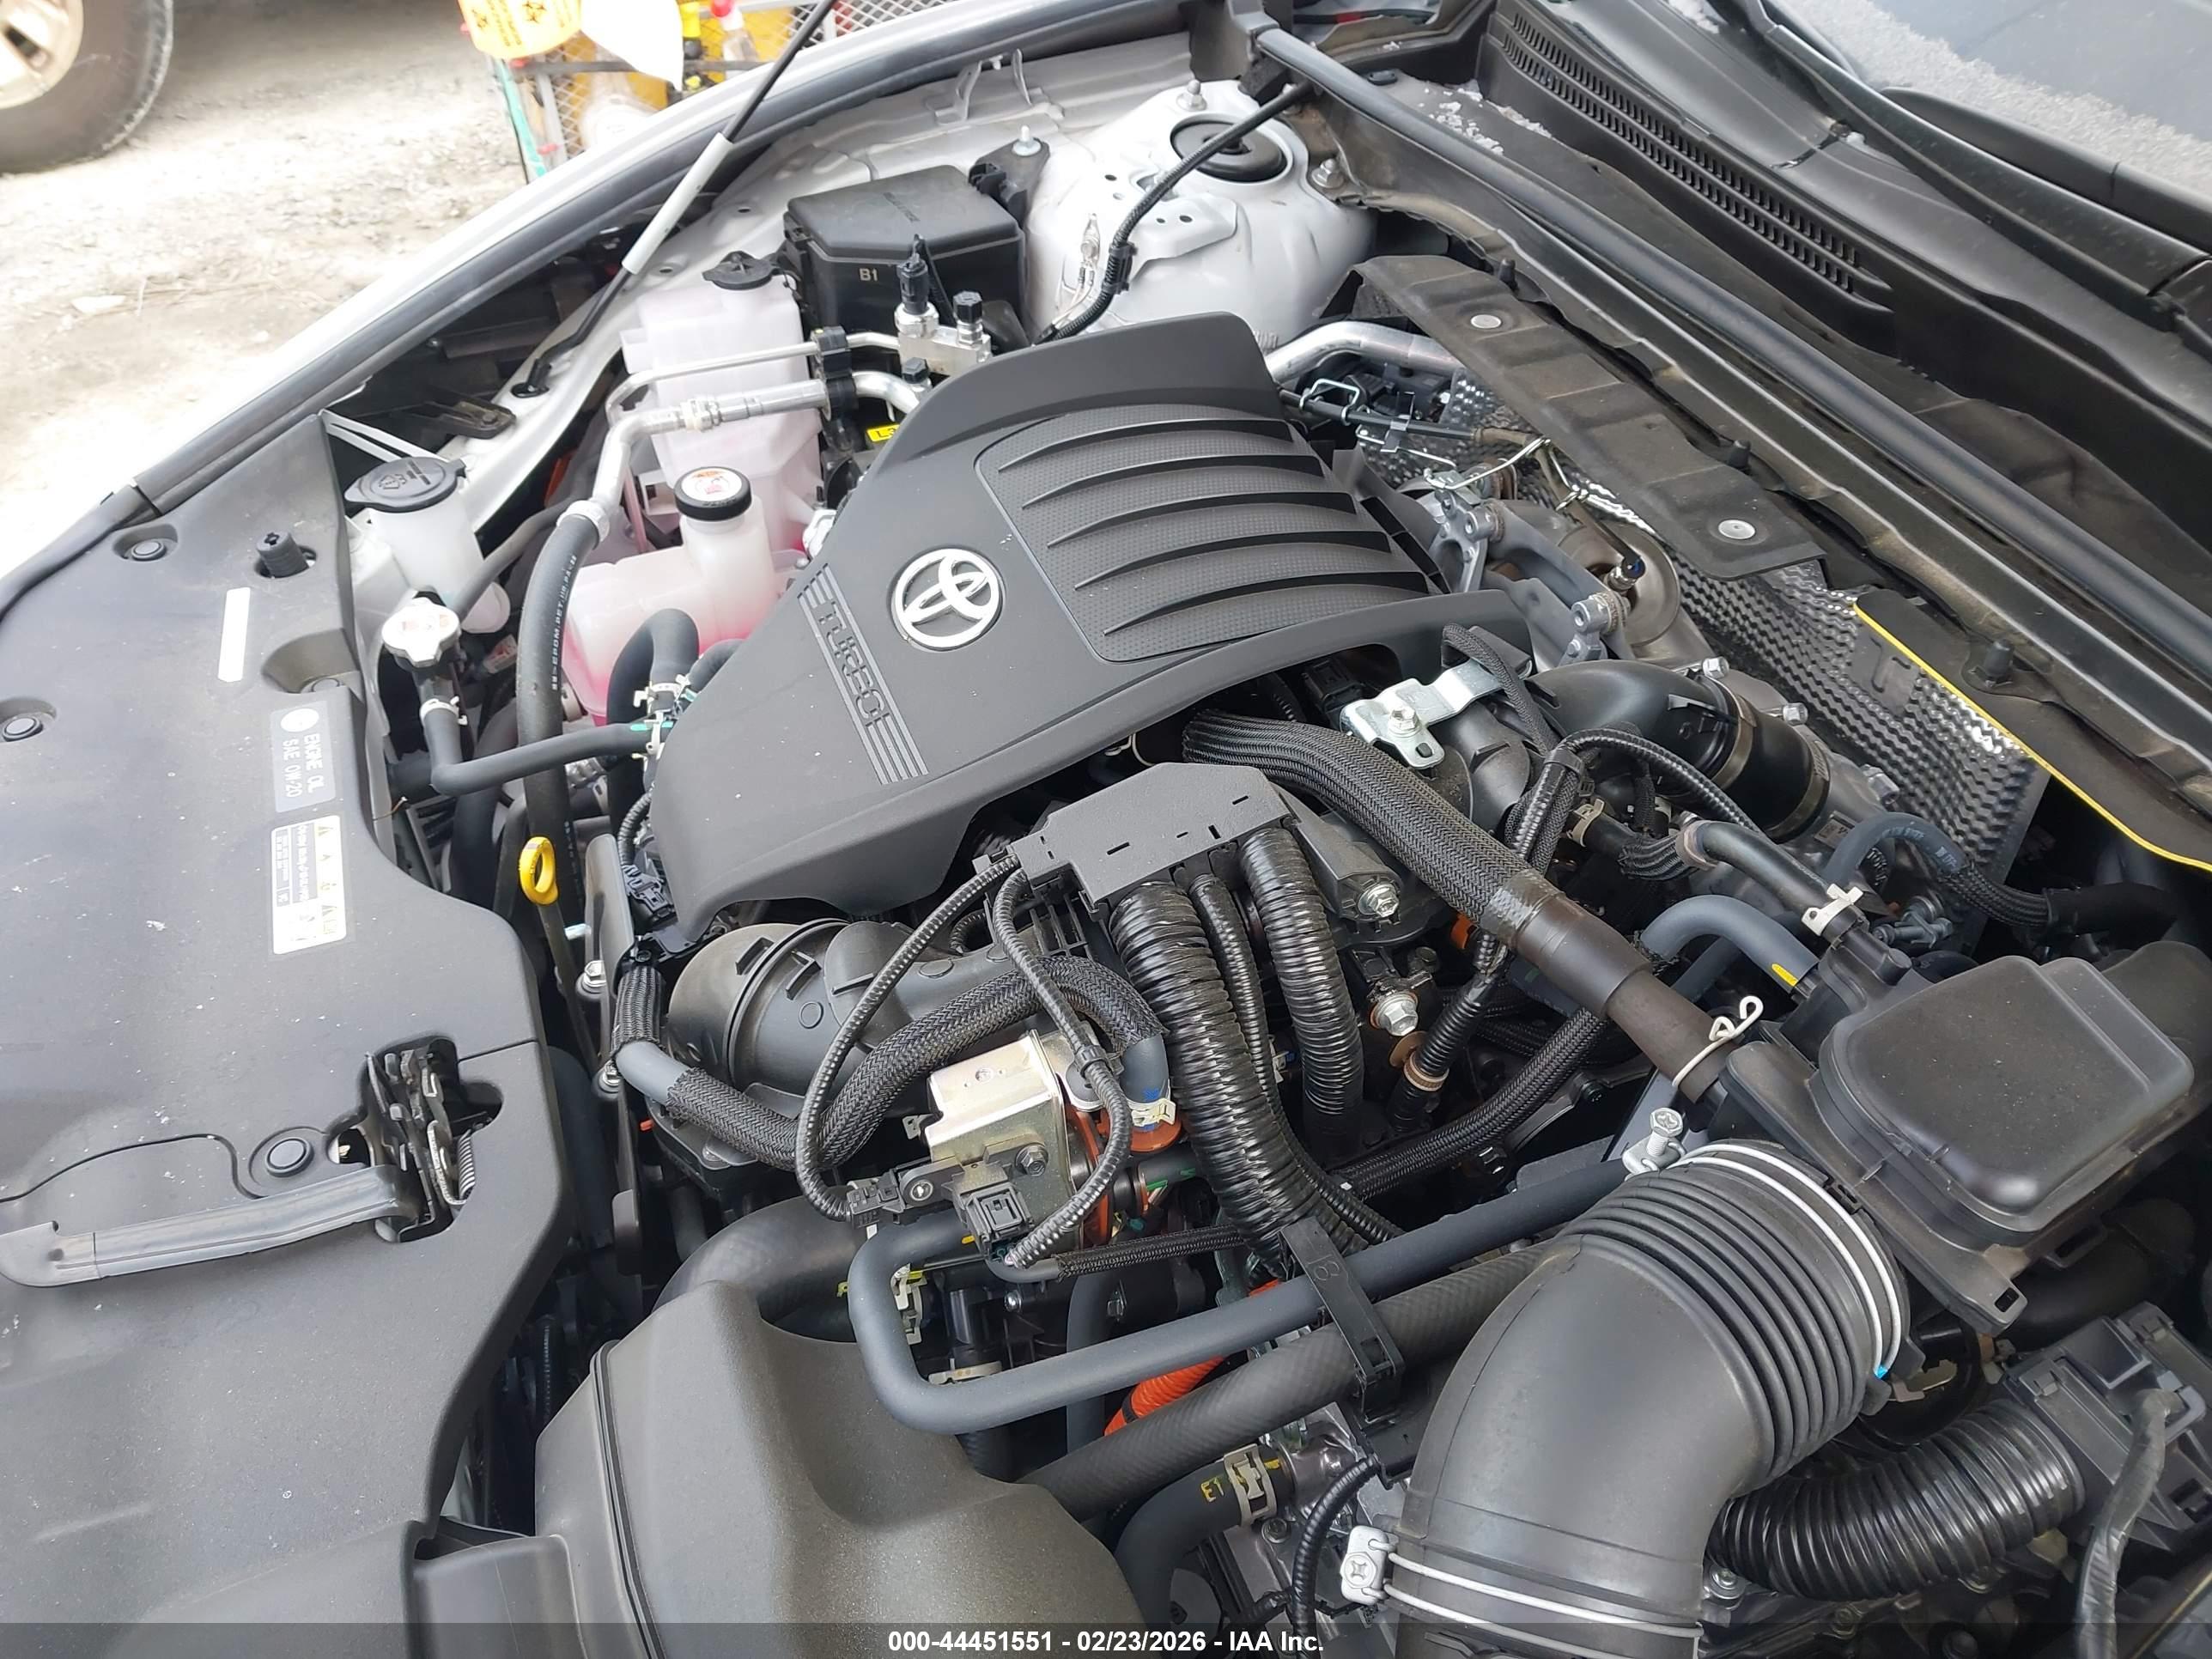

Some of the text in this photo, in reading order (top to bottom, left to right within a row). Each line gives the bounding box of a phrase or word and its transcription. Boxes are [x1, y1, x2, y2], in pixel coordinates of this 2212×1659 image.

[860, 268, 878, 282] B1
[818, 600, 885, 718] TURBO
[283, 738, 301, 761] SAE
[303, 732, 324, 771] ENGINE
[1200, 1476, 1224, 1503] E1
